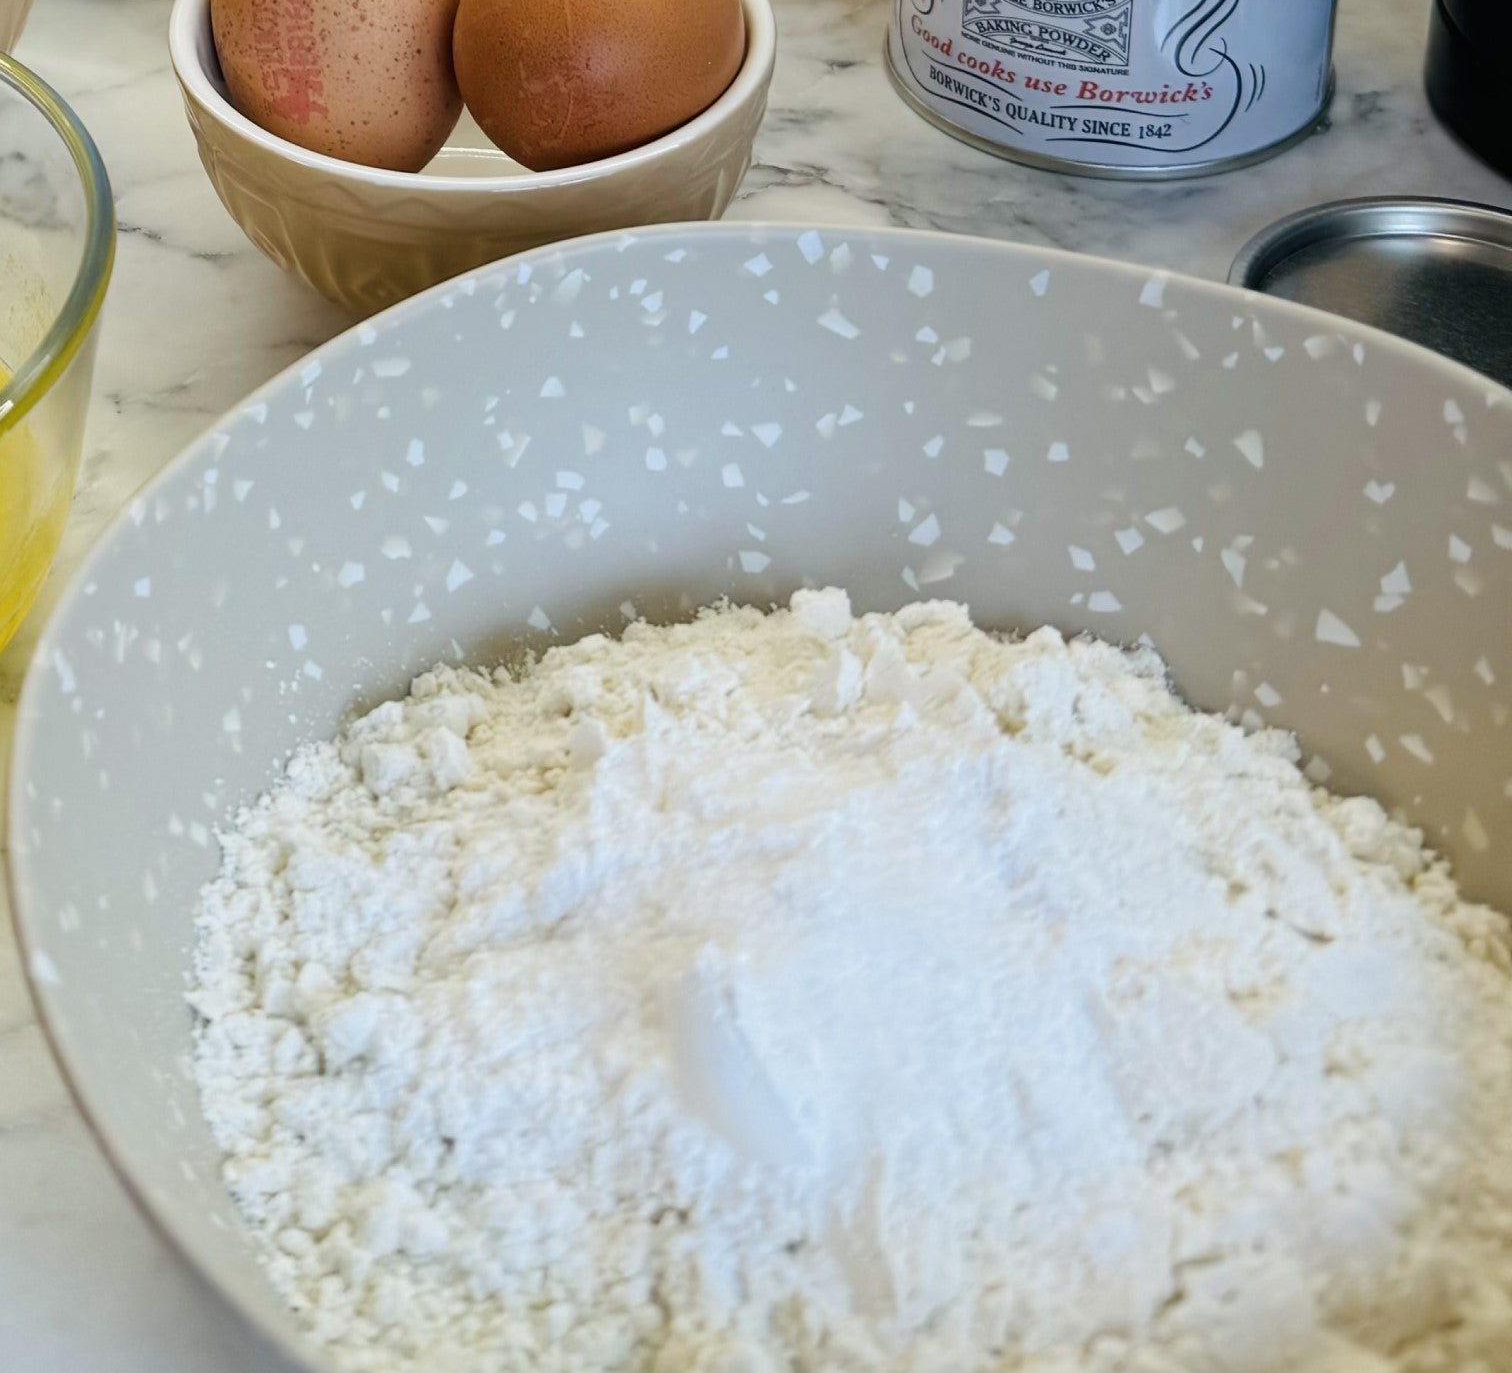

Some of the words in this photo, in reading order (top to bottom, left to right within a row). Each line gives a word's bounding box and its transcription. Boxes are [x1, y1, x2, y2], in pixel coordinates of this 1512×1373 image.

[911, 14, 953, 58] Good
[957, 48, 1017, 85] cooks
[1024, 74, 1069, 96] use
[1076, 78, 1215, 106] Borwick's
[961, 30, 981, 46] NONE
[981, 39, 1017, 58] GENUINE
[1016, 51, 1057, 68] WITHOUT
[1057, 60, 1078, 71] THIS
[1078, 64, 1131, 77] SIGNATURE
[975, 19, 1033, 36] BAKING
[1039, 27, 1113, 63] POWDER
[929, 64, 1001, 113] BORWICK'S
[1005, 101, 1079, 133] QUALITY
[1081, 118, 1132, 138] SINCE
[1138, 122, 1173, 141] 1842
